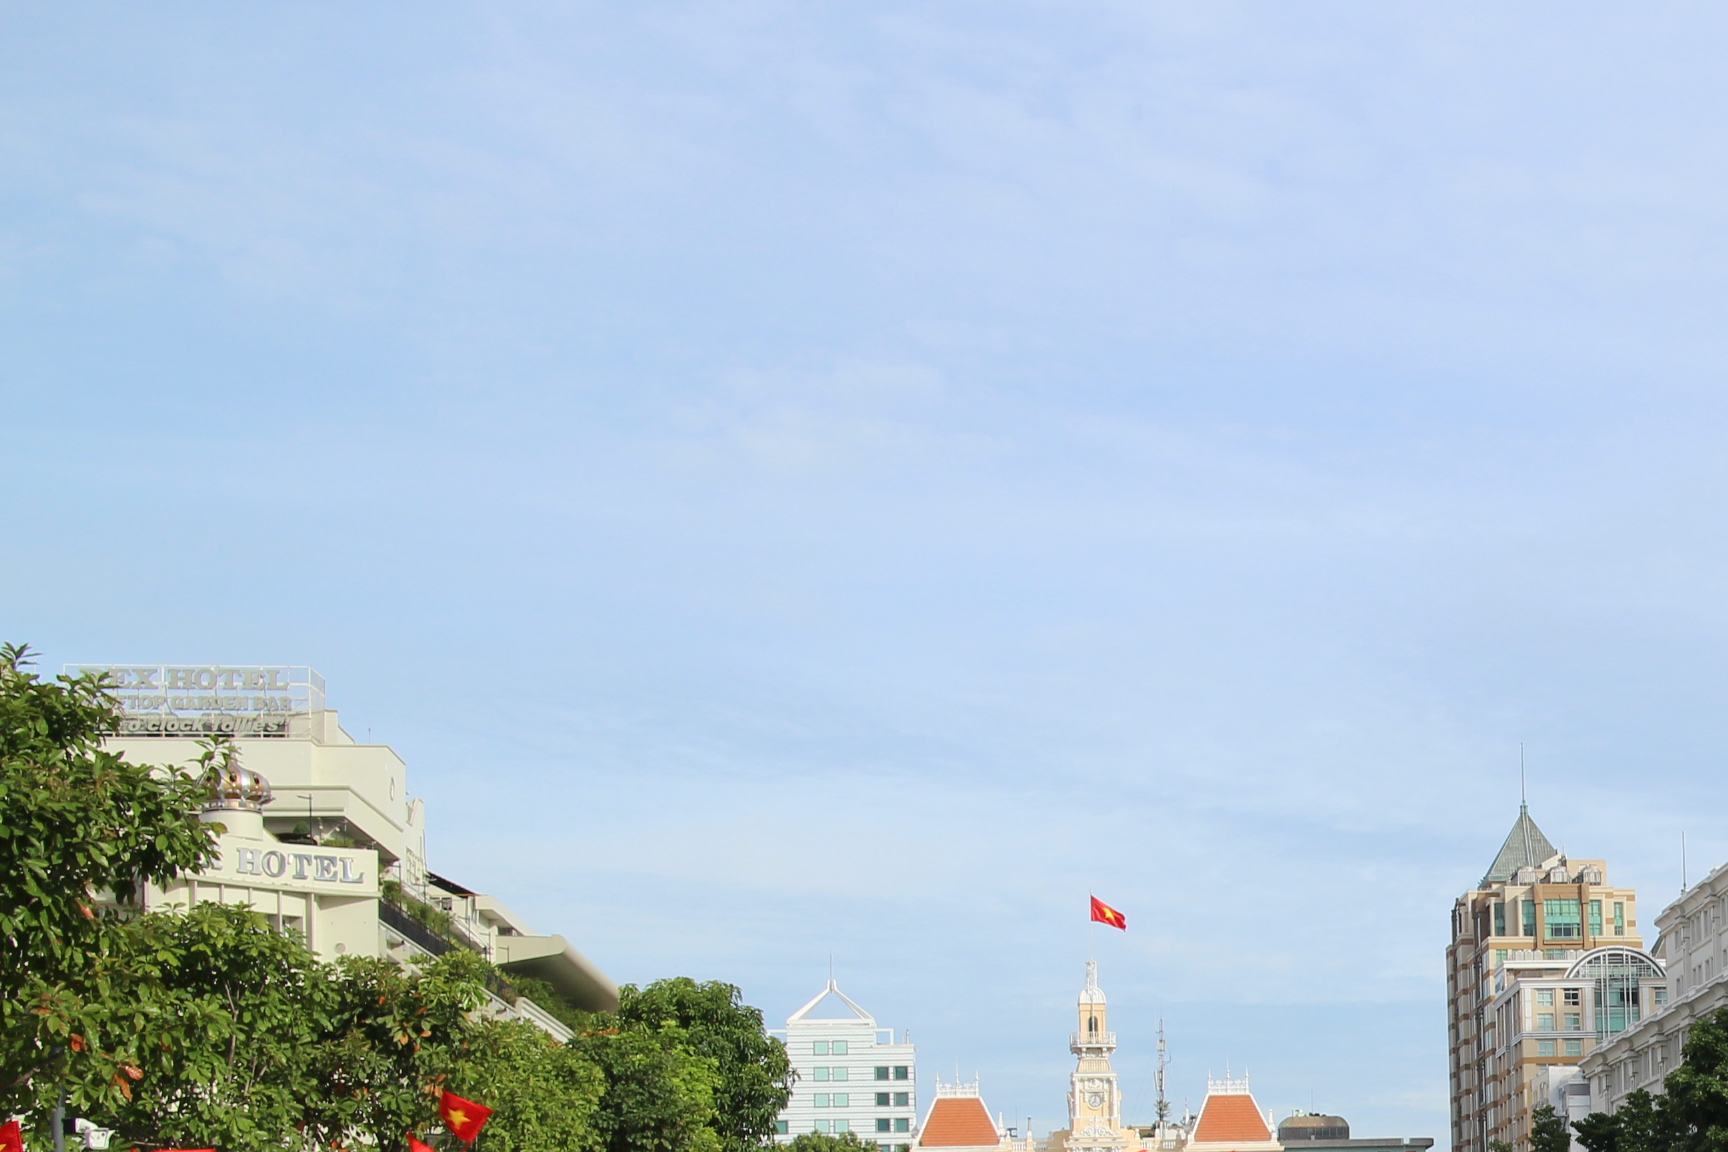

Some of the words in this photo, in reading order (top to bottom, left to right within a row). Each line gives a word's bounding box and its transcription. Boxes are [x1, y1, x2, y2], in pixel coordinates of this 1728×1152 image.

[167, 668, 289, 691] HOTEL
[172, 695, 248, 711] GARDEN
[254, 696, 292, 712] BAR
[236, 847, 364, 884] HOTEL
